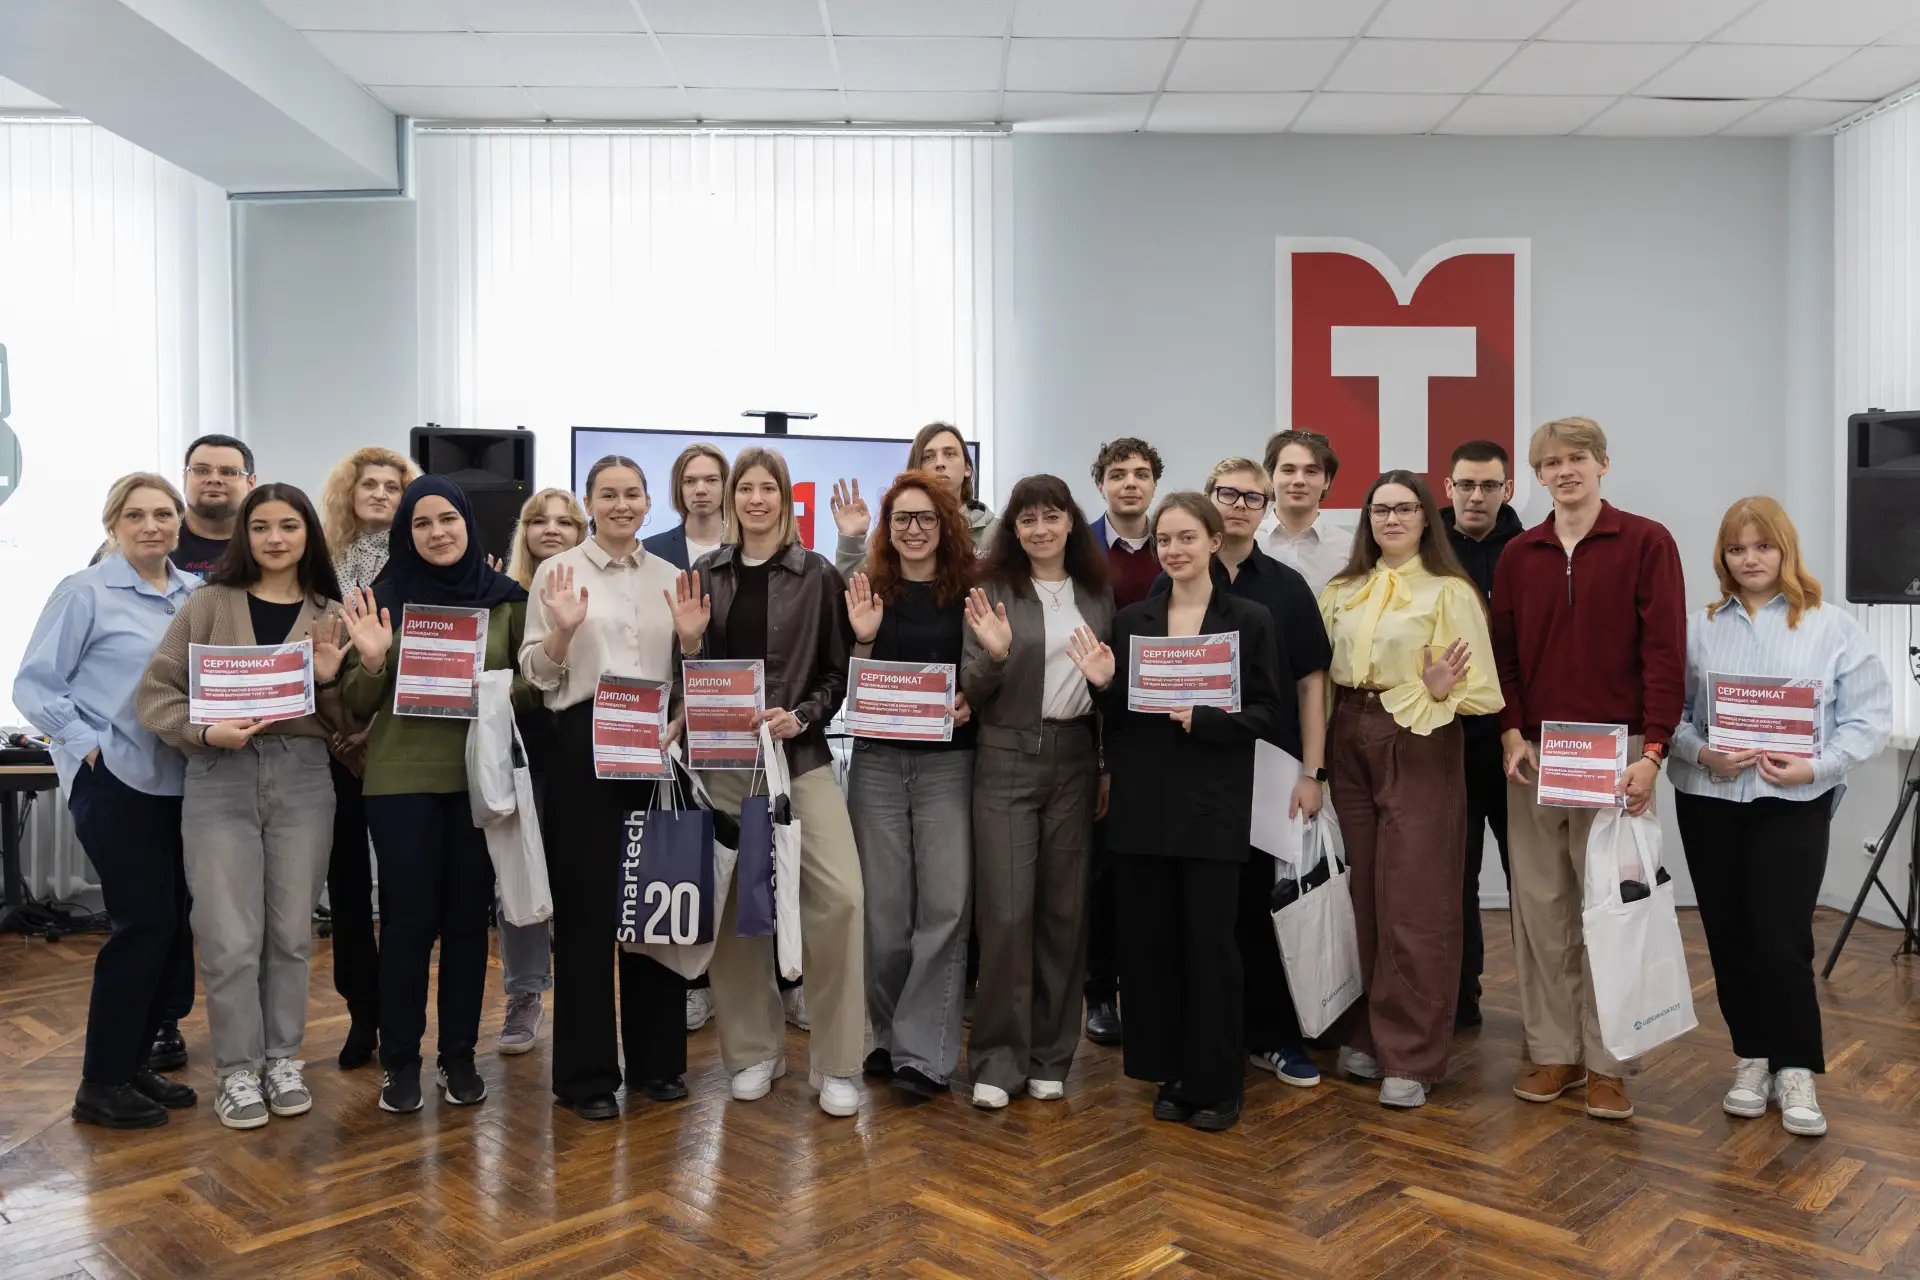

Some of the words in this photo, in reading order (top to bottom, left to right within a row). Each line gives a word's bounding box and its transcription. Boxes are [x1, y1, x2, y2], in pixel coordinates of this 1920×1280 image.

[406, 620, 454, 630] ДИПЛОМ
[1143, 649, 1207, 658] СЕРТИФИКАТ
[203, 658, 276, 668] СЕРТИФИКАТ
[688, 678, 732, 687] ДИПЛОМ
[860, 672, 924, 684] СЕРТИФИКАТ
[598, 690, 640, 703] ДИПЛОМ
[1718, 686, 1787, 699] СЕРТИФИКАТ
[1546, 739, 1592, 750] ДИПЛОМ
[617, 810, 646, 943] Smartech
[644, 881, 700, 945] 20
